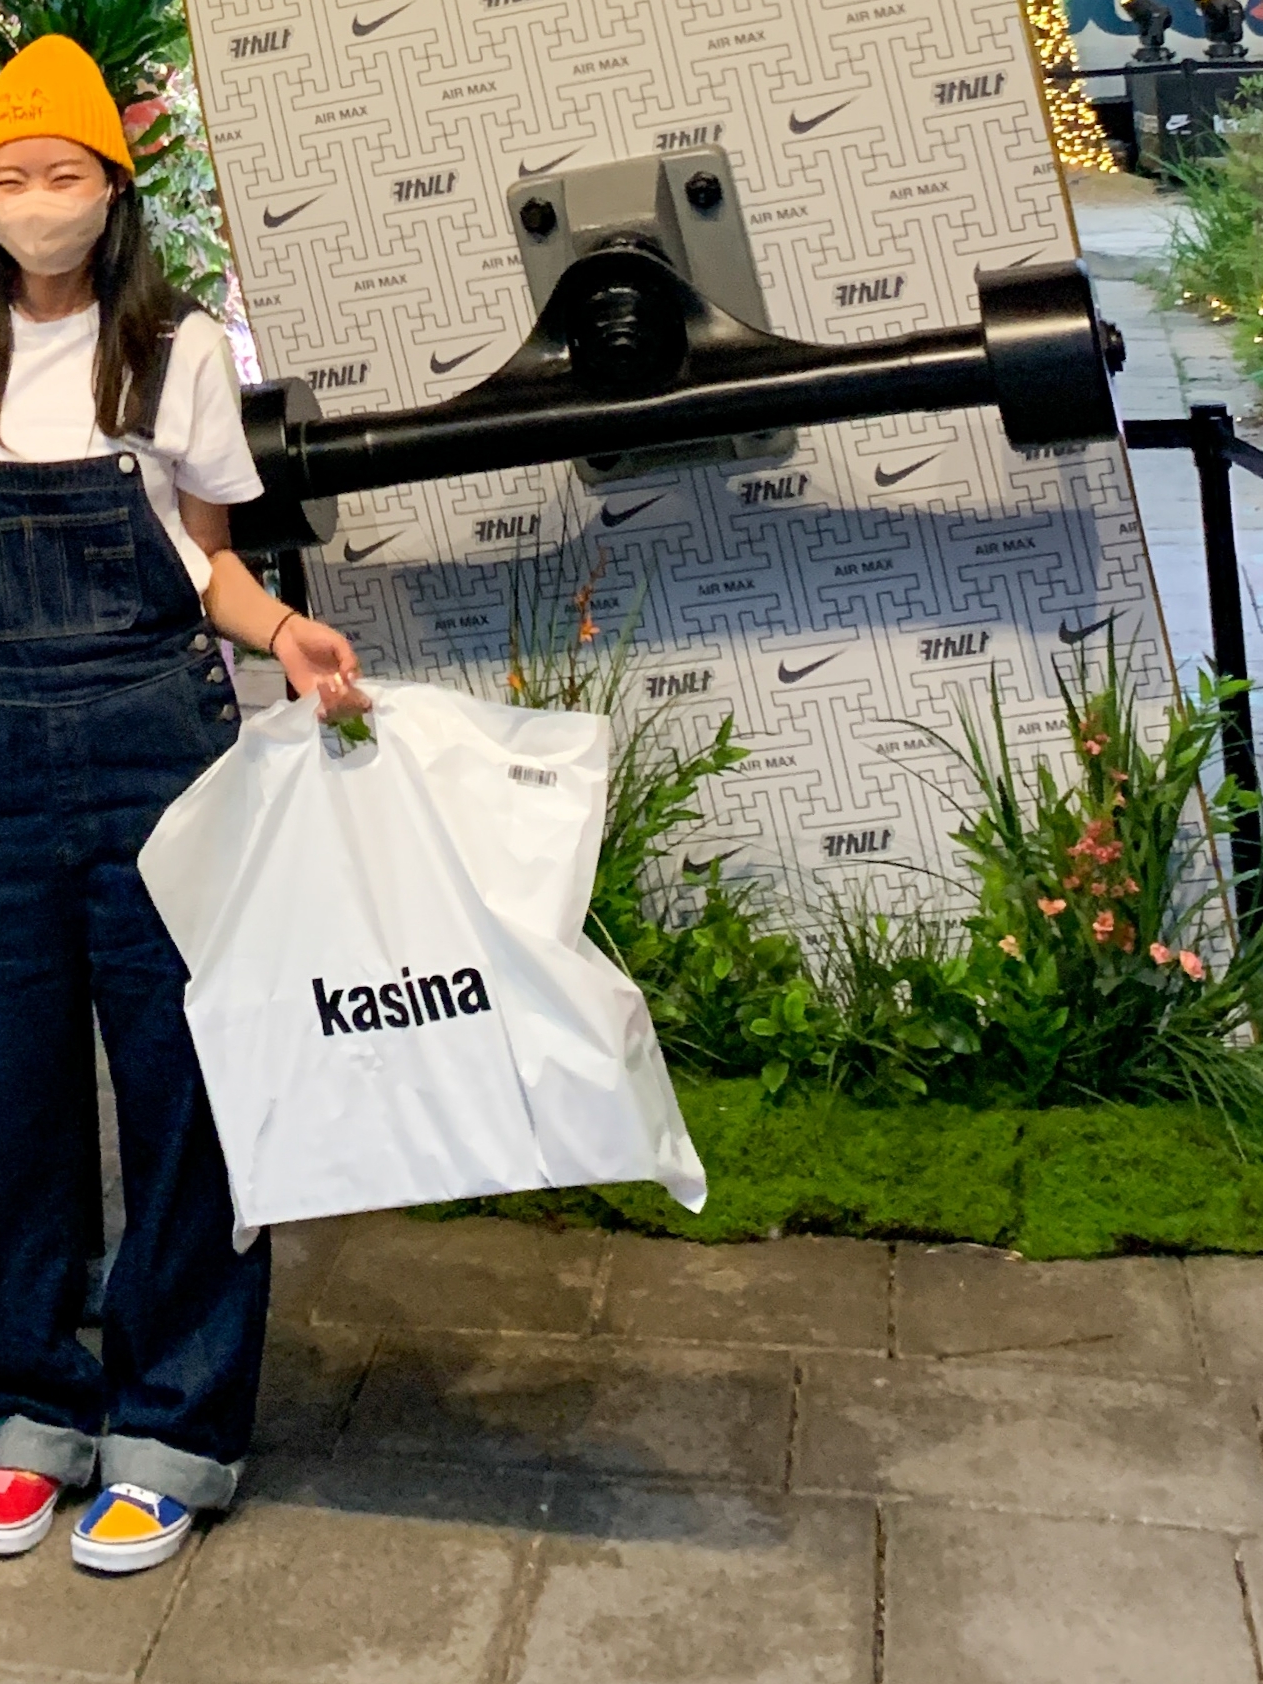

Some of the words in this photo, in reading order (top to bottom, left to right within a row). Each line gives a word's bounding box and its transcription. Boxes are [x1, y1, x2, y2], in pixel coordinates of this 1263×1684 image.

[846, 9, 873, 25] AIR
[875, 3, 906, 19] MAX
[707, 35, 734, 51] AIR
[735, 29, 766, 45] MAX
[572, 62, 597, 77] AIR
[598, 55, 630, 71] MAX
[441, 85, 467, 101] AIR
[469, 80, 497, 96] MAX
[314, 110, 339, 125] AIR
[340, 105, 368, 120] MAX
[214, 130, 243, 144] MAX
[888, 186, 916, 201] AIR
[918, 180, 949, 196] MAX
[749, 211, 775, 225] AIR
[777, 205, 808, 221] MAX
[481, 257, 504, 270] AIR
[353, 277, 377, 292] AIR
[379, 273, 408, 288] MAX
[253, 294, 282, 309] MAX
[974, 542, 1002, 557] AIR
[1004, 537, 1036, 552] MAX
[834, 562, 860, 577] AIR
[862, 558, 894, 573] MAX
[698, 581, 724, 595] AIR
[726, 578, 756, 593] MAX
[590, 598, 619, 610] MAX
[435, 618, 457, 631] AIR
[459, 615, 489, 628] MAX
[1018, 722, 1042, 735] AIR
[876, 743, 902, 755] AIR
[903, 737, 935, 750] MAX
[738, 760, 765, 773] AIR
[765, 755, 798, 767] MAX
[312, 967, 492, 1036] kasina
